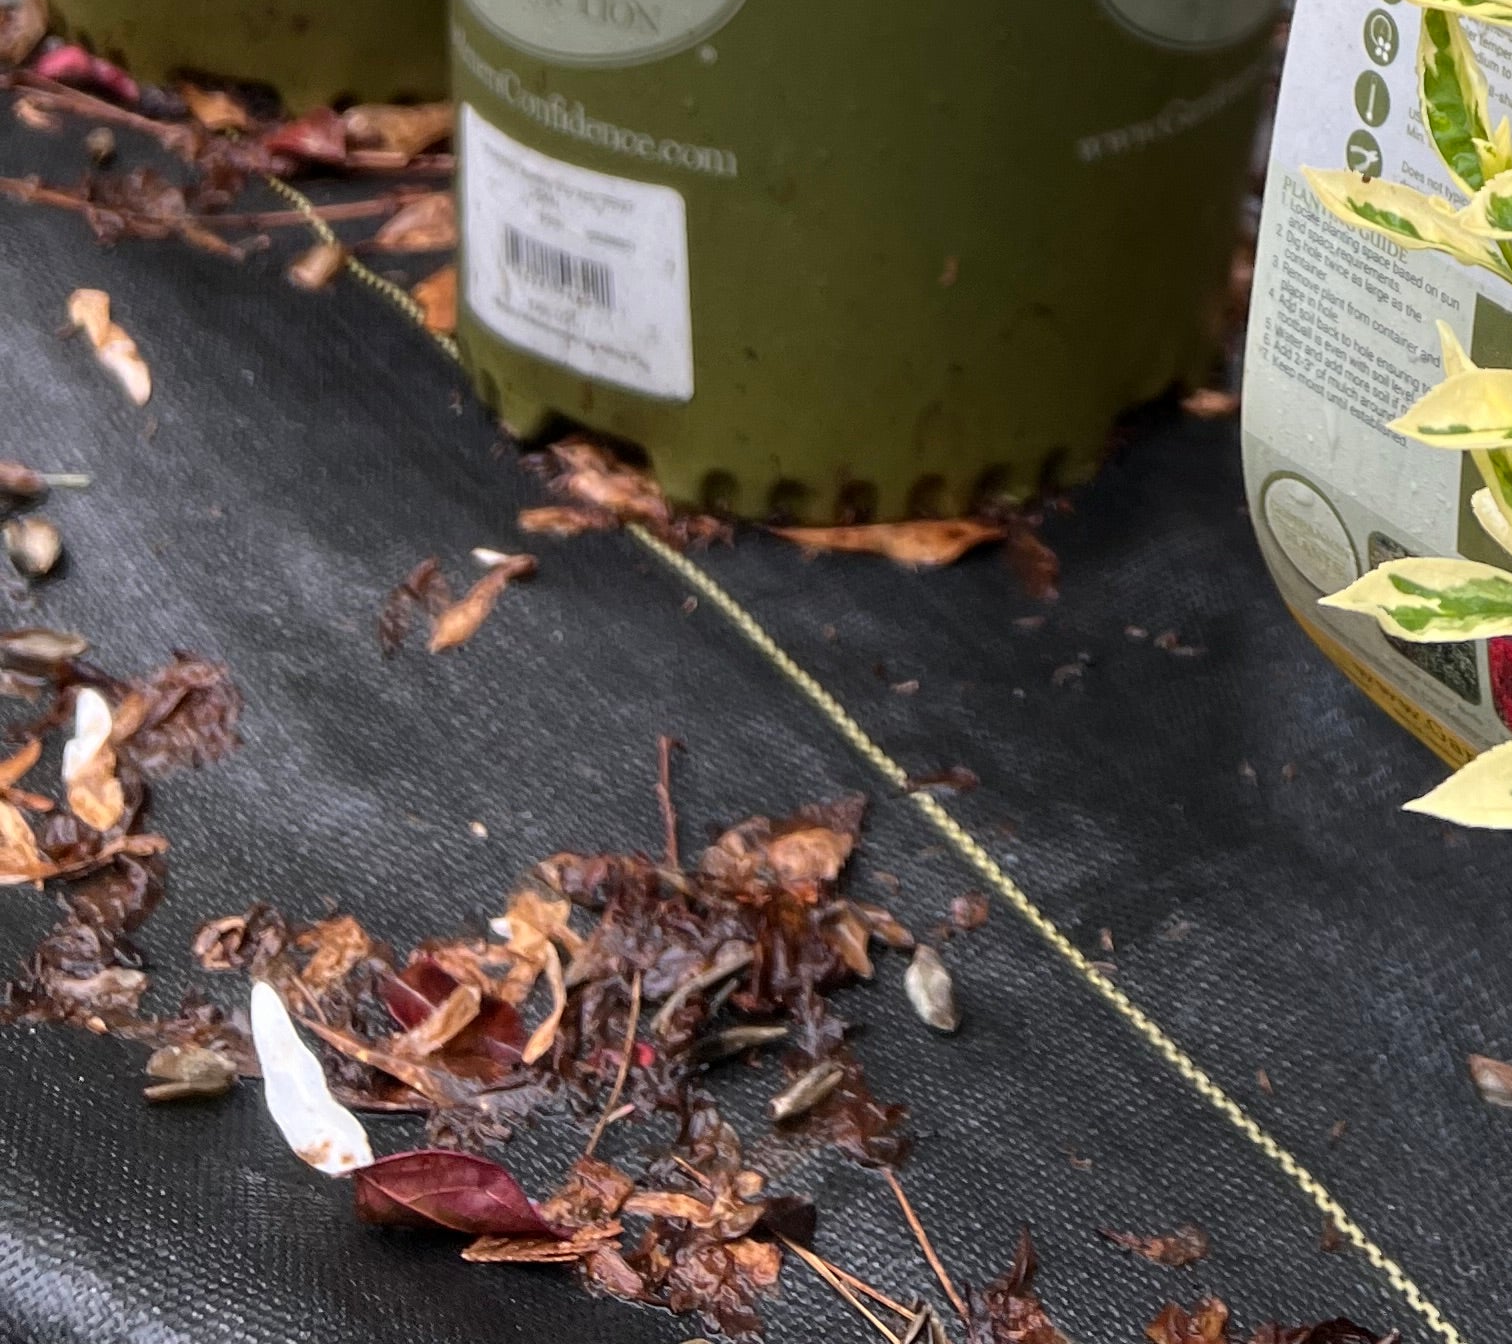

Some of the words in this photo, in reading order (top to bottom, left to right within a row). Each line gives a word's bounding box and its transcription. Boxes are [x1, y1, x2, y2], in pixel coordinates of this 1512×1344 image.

[1501, 65, 1512, 81] to
[1401, 160, 1426, 183] Does
[1426, 174, 1444, 193] not
[1288, 217, 1307, 236] and
[1289, 198, 1321, 227] Locate
[1321, 216, 1361, 254] planting
[1361, 243, 1391, 270] space
[1392, 260, 1423, 291] based
[1424, 280, 1438, 299] on
[1440, 291, 1461, 311] sun
[1358, 224, 1409, 265] GUIDE
[1280, 278, 1306, 304] place
[1306, 292, 1316, 309] in
[1285, 230, 1302, 251] Dig
[1302, 240, 1323, 264] hole
[1323, 255, 1350, 280] twice
[1351, 273, 1363, 289] as
[1364, 279, 1390, 306] large
[1391, 297, 1403, 312] as
[1405, 303, 1422, 324] the
[1281, 261, 1321, 296] Remove
[1320, 287, 1345, 314] plant
[1346, 301, 1371, 328] from
[1371, 318, 1419, 357] container
[1419, 344, 1442, 369] and
[1273, 338, 1293, 360] Add
[1315, 363, 1327, 381] of
[1327, 373, 1359, 402] mulch
[1274, 322, 1304, 351] Water
[1304, 342, 1323, 364] and
[1324, 355, 1344, 377] add
[1343, 369, 1371, 393] more
[1371, 382, 1391, 404] soil
[1297, 303, 1316, 326] soil
[1316, 316, 1340, 342] back
[1341, 330, 1353, 348] to
[1353, 337, 1375, 363] hole
[1375, 354, 1421, 394] ensuring
[1313, 333, 1323, 347] is
[1323, 339, 1348, 362] even
[1349, 353, 1371, 376] with
[1371, 366, 1390, 388] soil
[1271, 354, 1297, 379] Keep
[1297, 371, 1326, 398] moist
[1325, 389, 1350, 411] until
